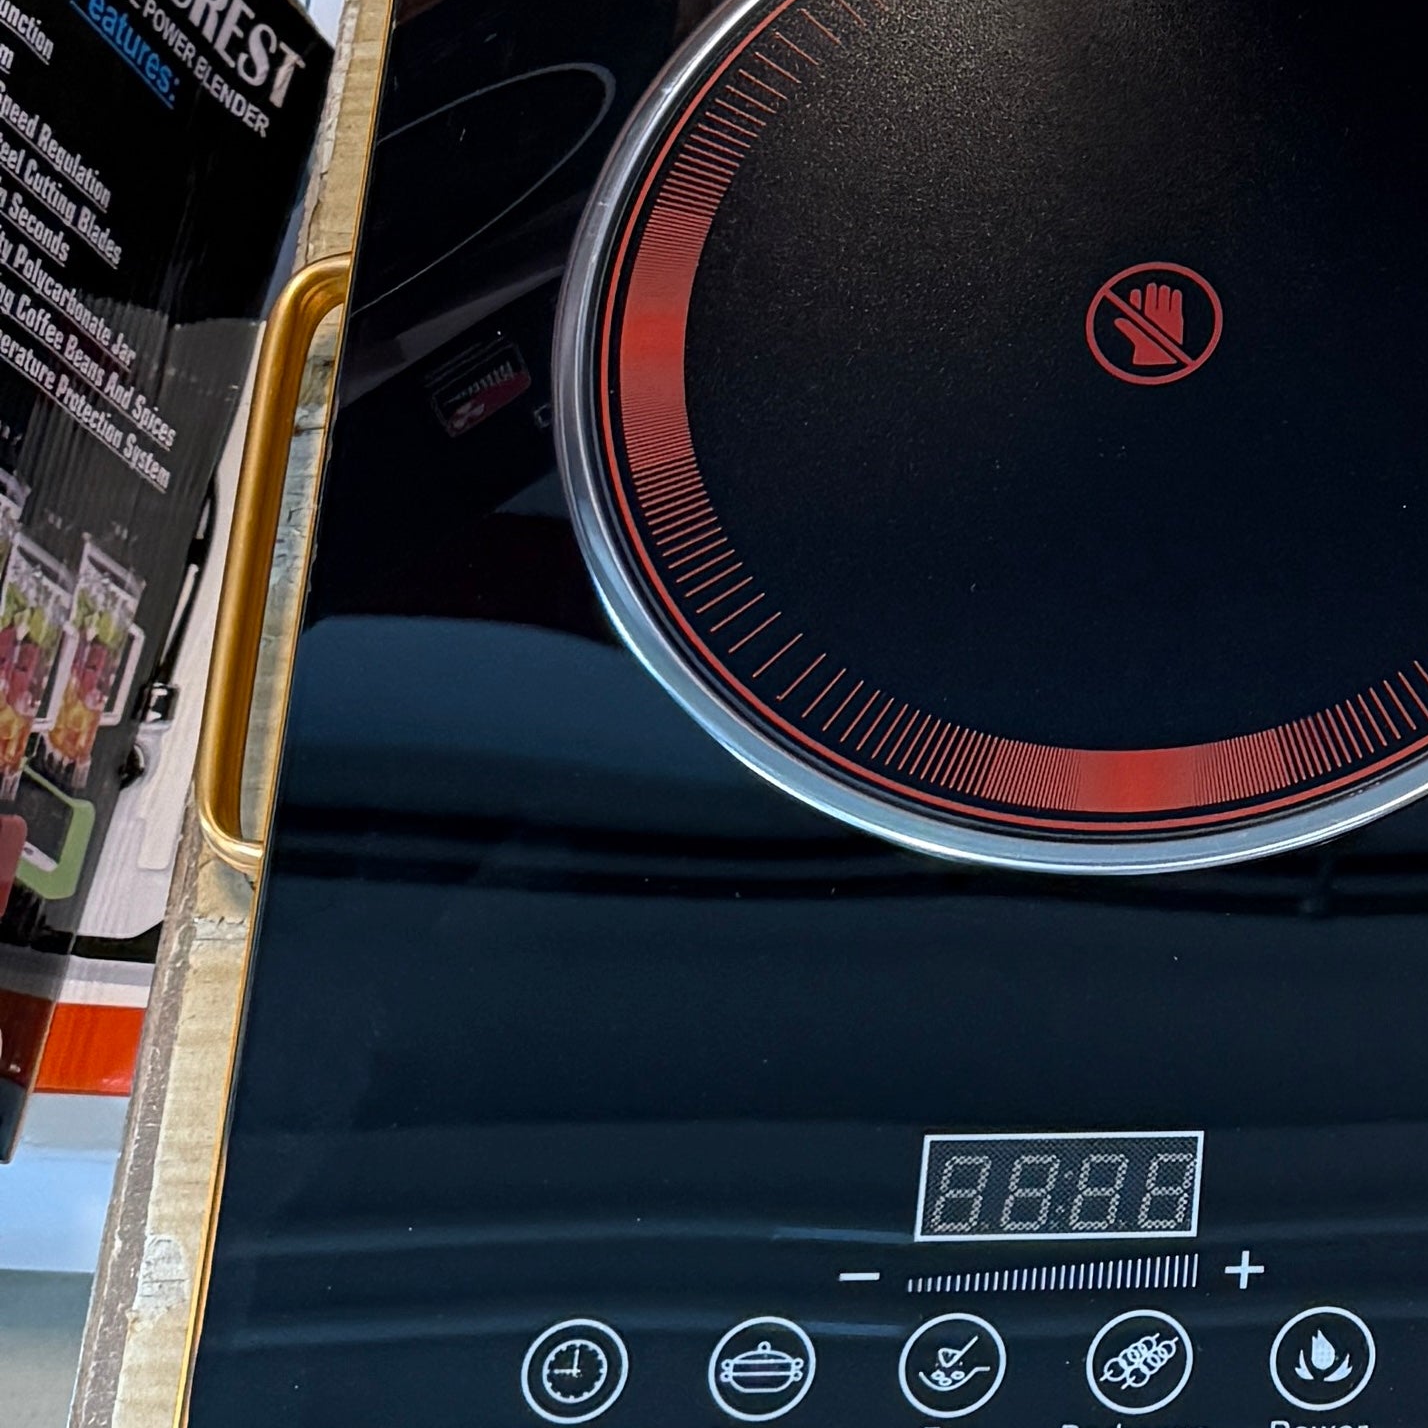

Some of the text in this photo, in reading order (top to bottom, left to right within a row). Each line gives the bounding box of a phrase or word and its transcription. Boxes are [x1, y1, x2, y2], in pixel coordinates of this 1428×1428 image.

[142, 1, 197, 68] POWER
[196, 56, 271, 138] BLENDER
[0, 132, 122, 265] eel Cutting Blades
[8, 191, 71, 262] Seconds
[37, 122, 112, 209] Regulation
[13, 243, 110, 348] Polycarbonate
[111, 331, 136, 368] Jar
[16, 293, 65, 351] Coffee
[64, 333, 104, 388] Beans
[104, 370, 136, 411] And
[131, 393, 177, 449] Spices
[0, 326, 171, 490] erature Protection System
